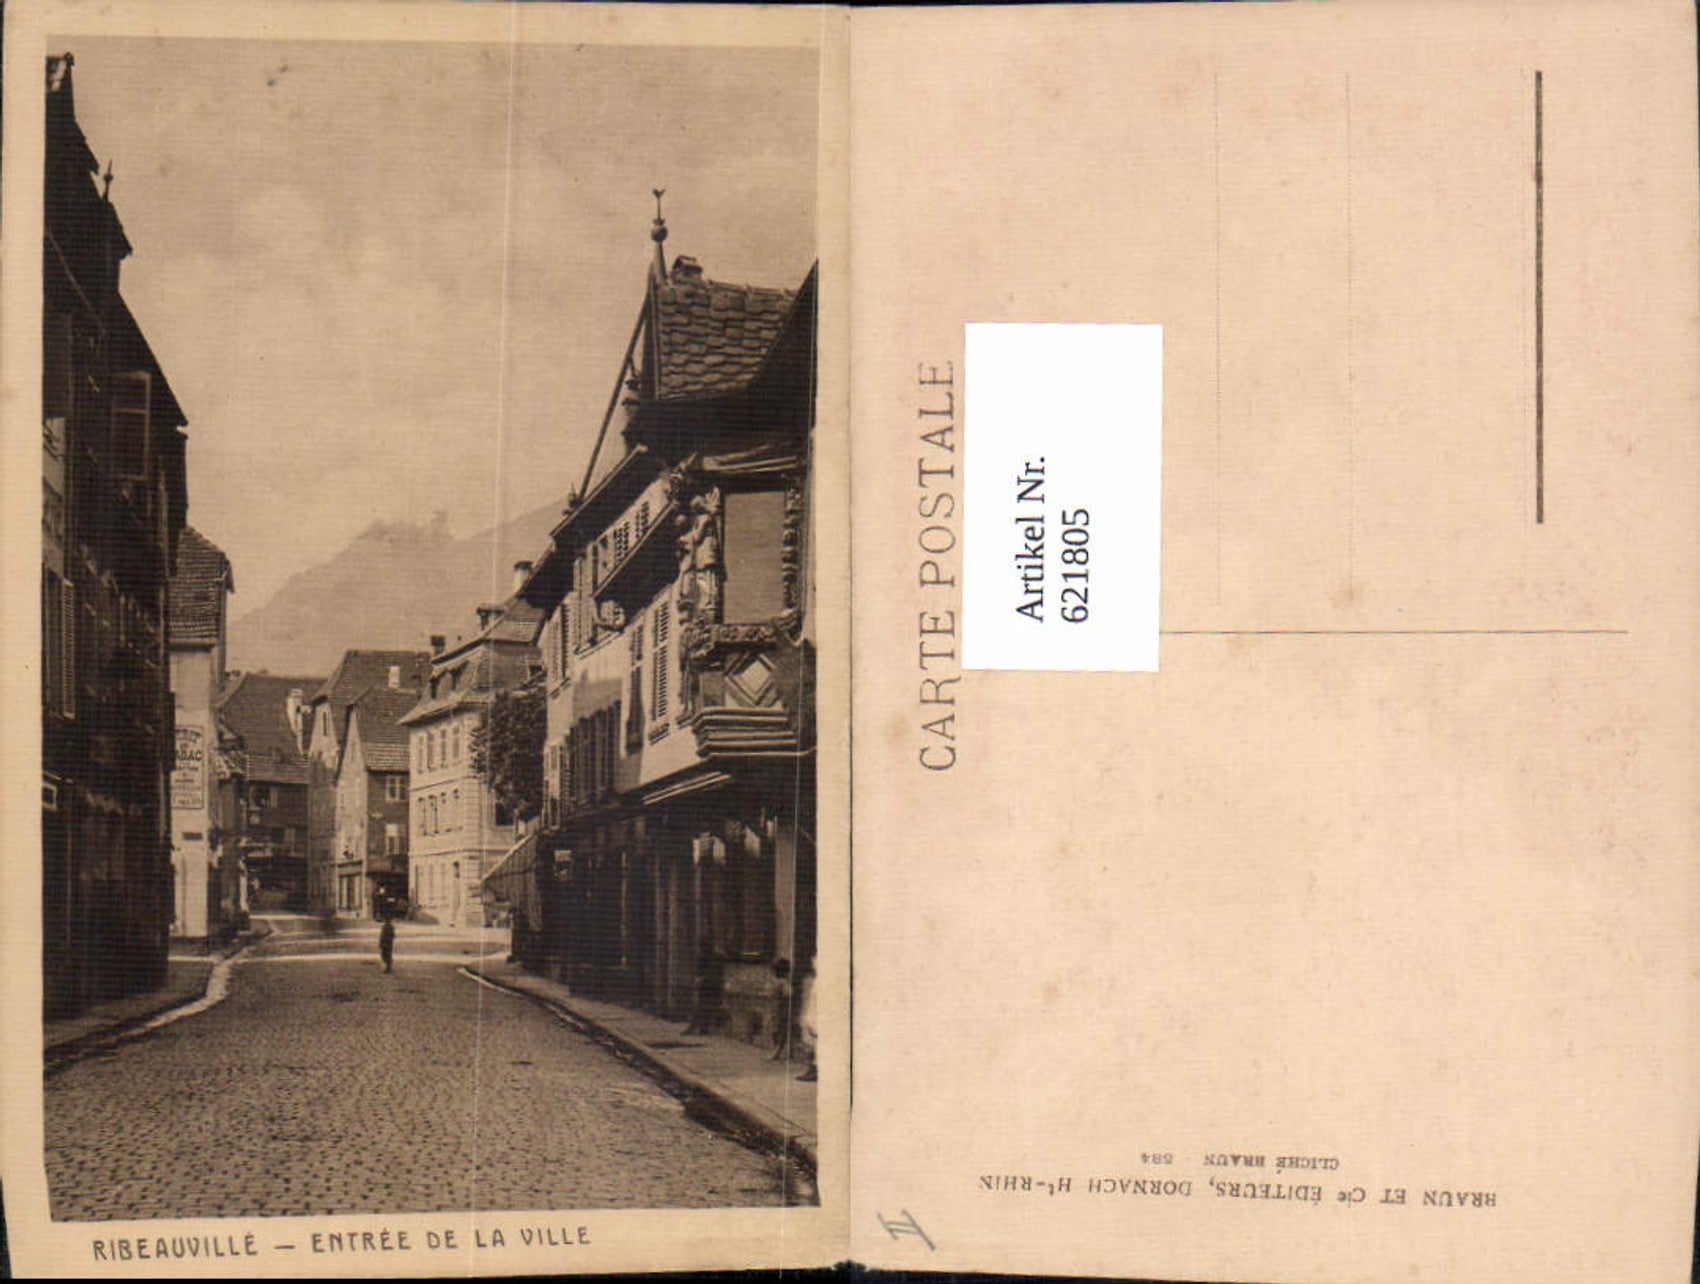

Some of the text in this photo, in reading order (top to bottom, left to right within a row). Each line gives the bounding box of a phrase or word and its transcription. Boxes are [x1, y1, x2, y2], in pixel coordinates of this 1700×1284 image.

[1015, 456, 1045, 622] Artikel Nr.
[918, 361, 961, 772] CARTE POSTALE
[1061, 508, 1090, 624] 621805
[1204, 1154, 1266, 1167] BRAUN
[1275, 1156, 1340, 1174] CLICHÉ
[1088, 1178, 1193, 1197] DORNACH
[1209, 1176, 1322, 1206] ÉDITEURS,
[1379, 1188, 1407, 1205] ET
[1423, 1189, 1497, 1208] BRAUN
[93, 1232, 258, 1261] RIBEAUVILLÉ
[311, 1227, 412, 1255] ENTRÉE
[426, 1229, 458, 1250] DE
[475, 1228, 506, 1249] LA
[520, 1225, 592, 1247] VILLE
